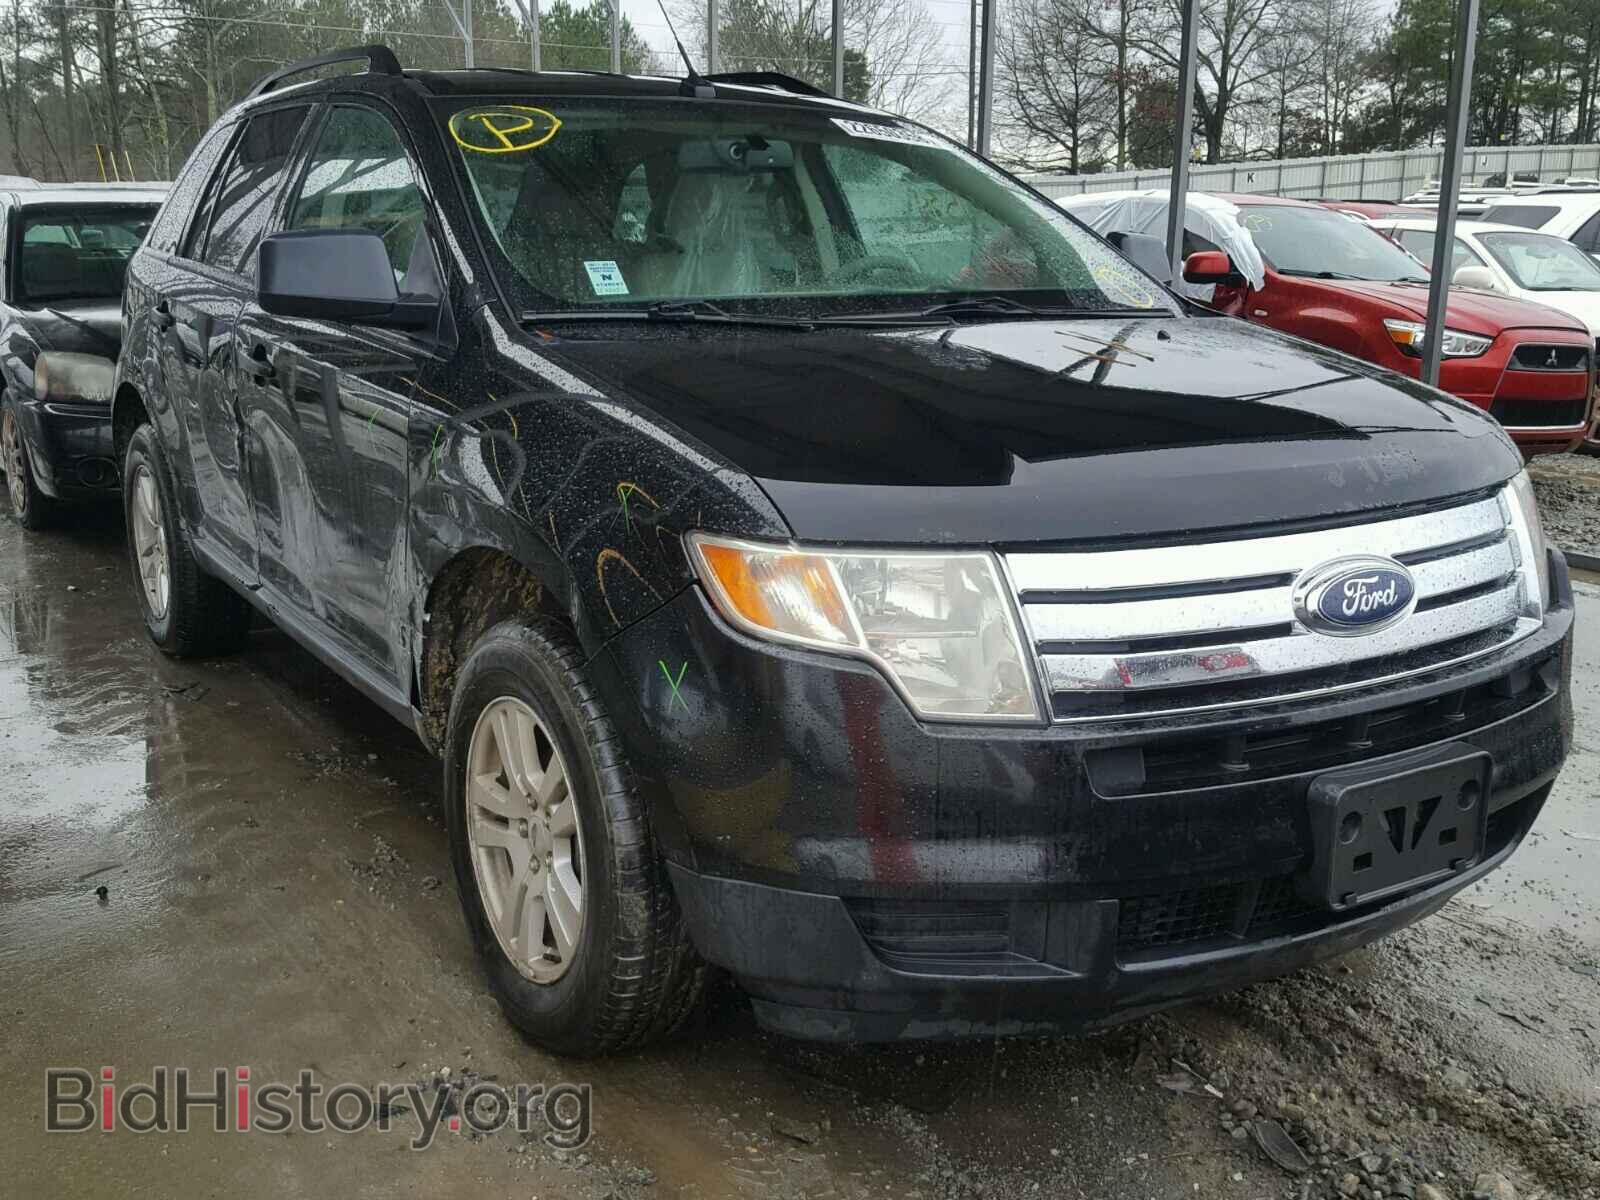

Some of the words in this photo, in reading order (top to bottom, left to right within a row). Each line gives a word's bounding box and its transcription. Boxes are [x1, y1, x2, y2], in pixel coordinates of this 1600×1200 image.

[469, 113, 533, 149] P
[1247, 172, 1256, 184] K
[1342, 575, 1398, 616] Ford
